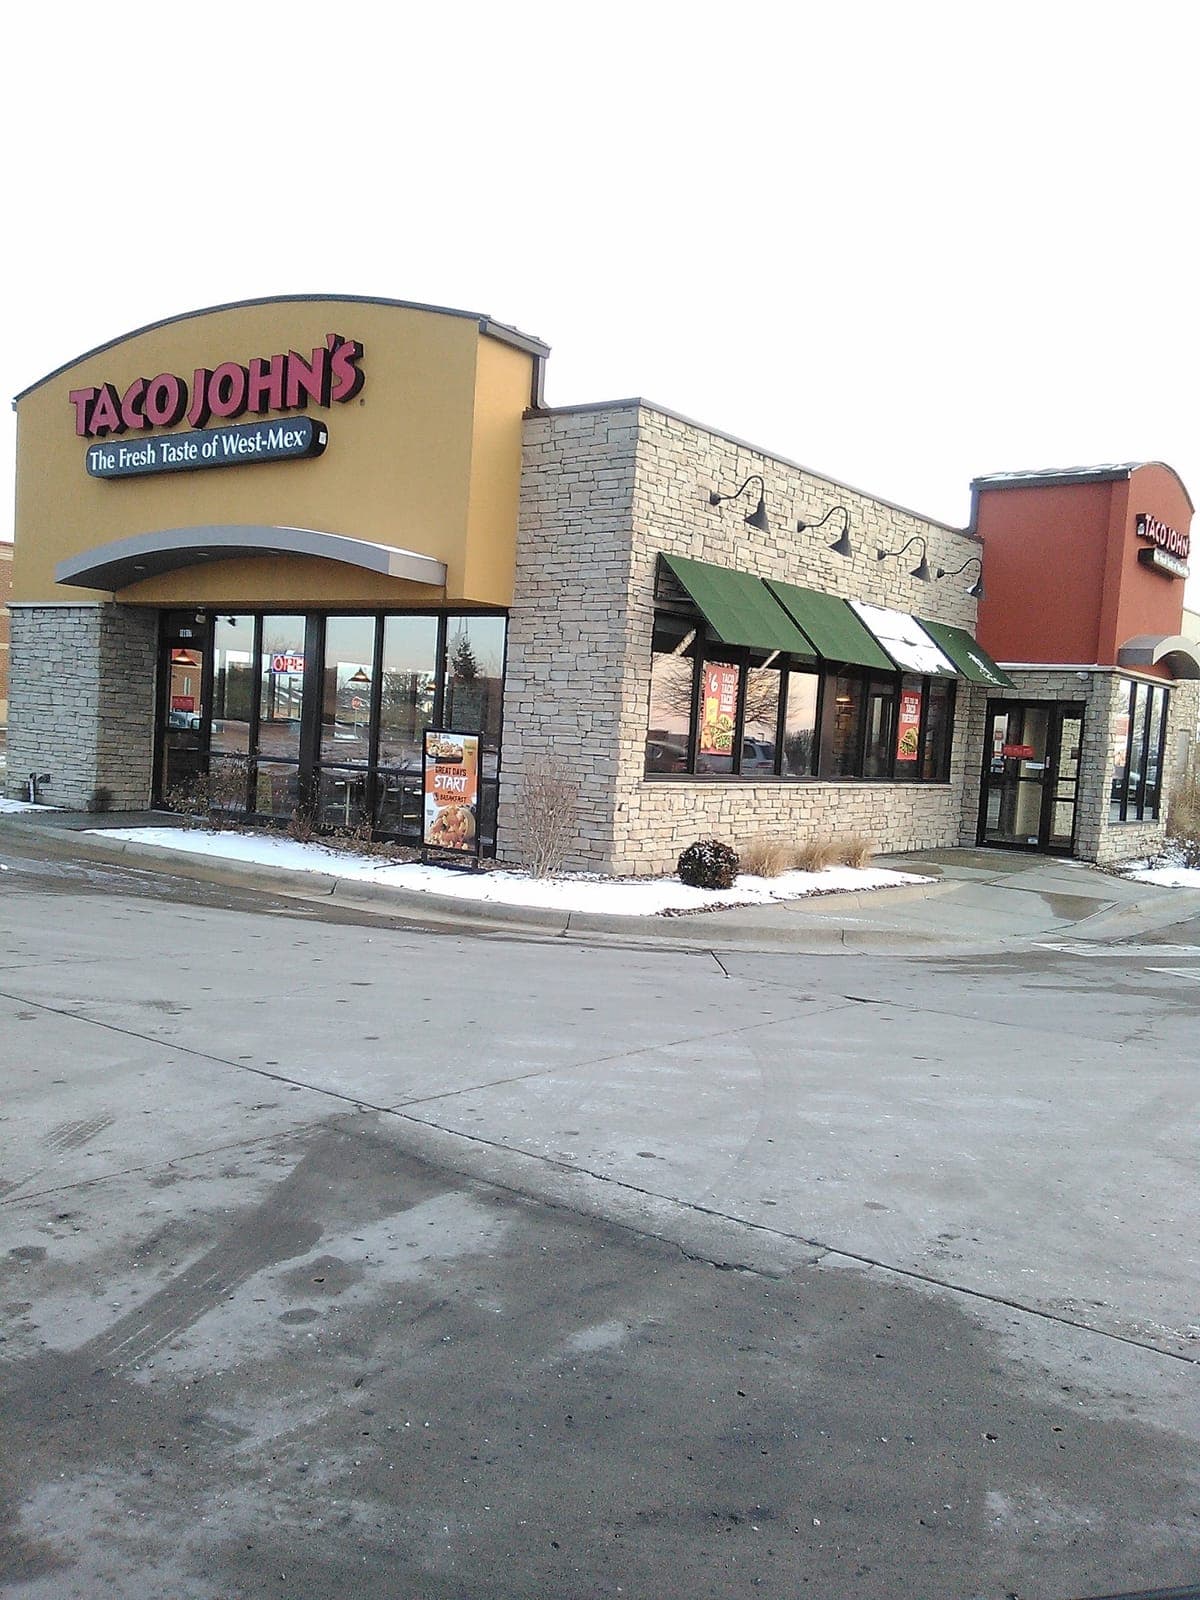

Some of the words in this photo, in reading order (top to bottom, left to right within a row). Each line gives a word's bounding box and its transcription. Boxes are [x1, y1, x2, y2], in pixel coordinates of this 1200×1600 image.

[69, 372, 183, 437] TACO
[186, 333, 361, 429] JOHN'S
[89, 450, 115, 471] The
[119, 444, 156, 468] Fresh
[160, 440, 198, 463] Taste
[202, 435, 218, 458] of
[221, 427, 304, 455] West-Mex
[1145, 513, 1167, 545] TACO
[273, 655, 304, 672] OPE
[435, 766, 451, 775] GREAT
[452, 768, 467, 776] DAYS
[434, 775, 468, 793] START
